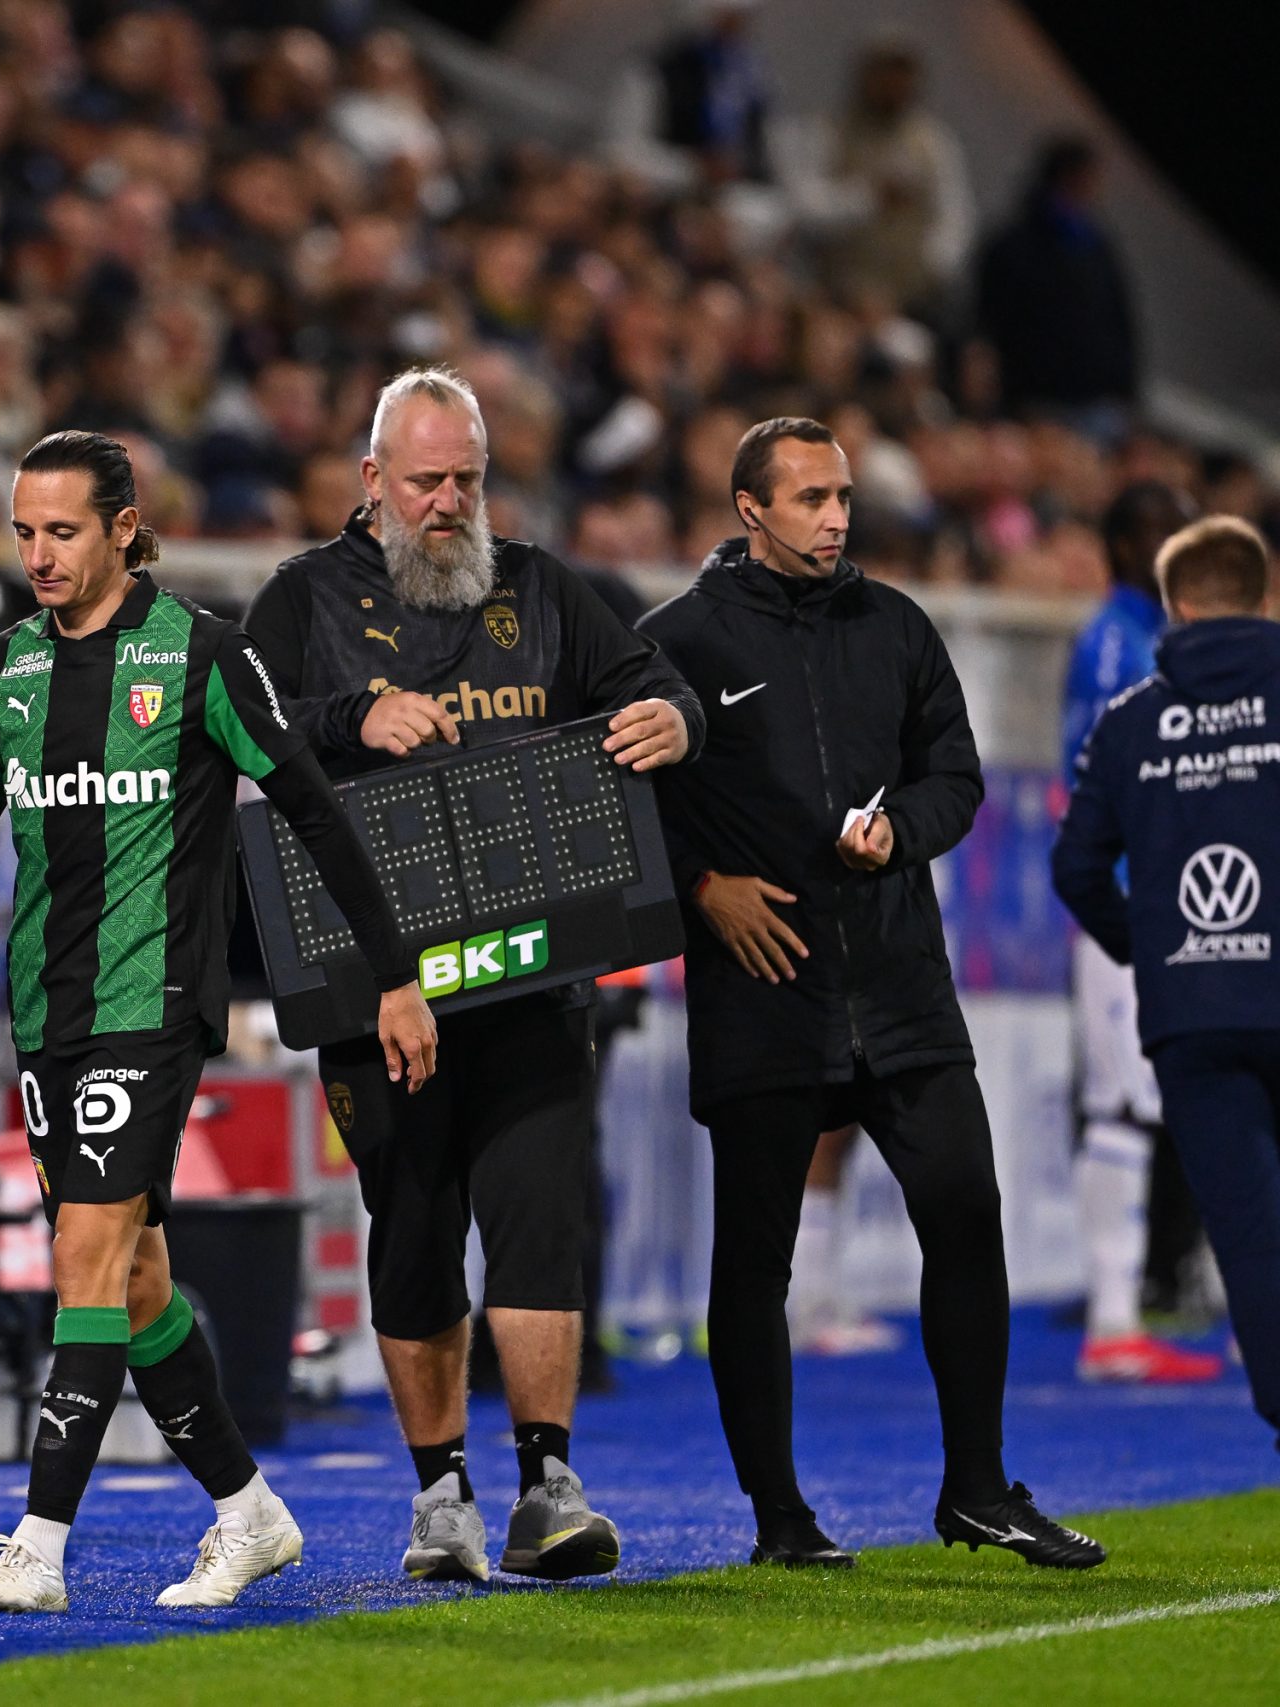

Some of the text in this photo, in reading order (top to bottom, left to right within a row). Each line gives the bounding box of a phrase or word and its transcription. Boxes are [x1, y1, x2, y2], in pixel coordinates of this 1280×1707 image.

[15, 650, 48, 666] GROUPE
[117, 643, 187, 665] Nexans
[1, 659, 53, 677] LEMPEREUR
[242, 647, 289, 730] AUSHOPPING
[131, 694, 147, 724] RCL
[4, 757, 170, 809] Auchan
[422, 928, 544, 991] BKT
[55, 1392, 99, 1409] LENS
